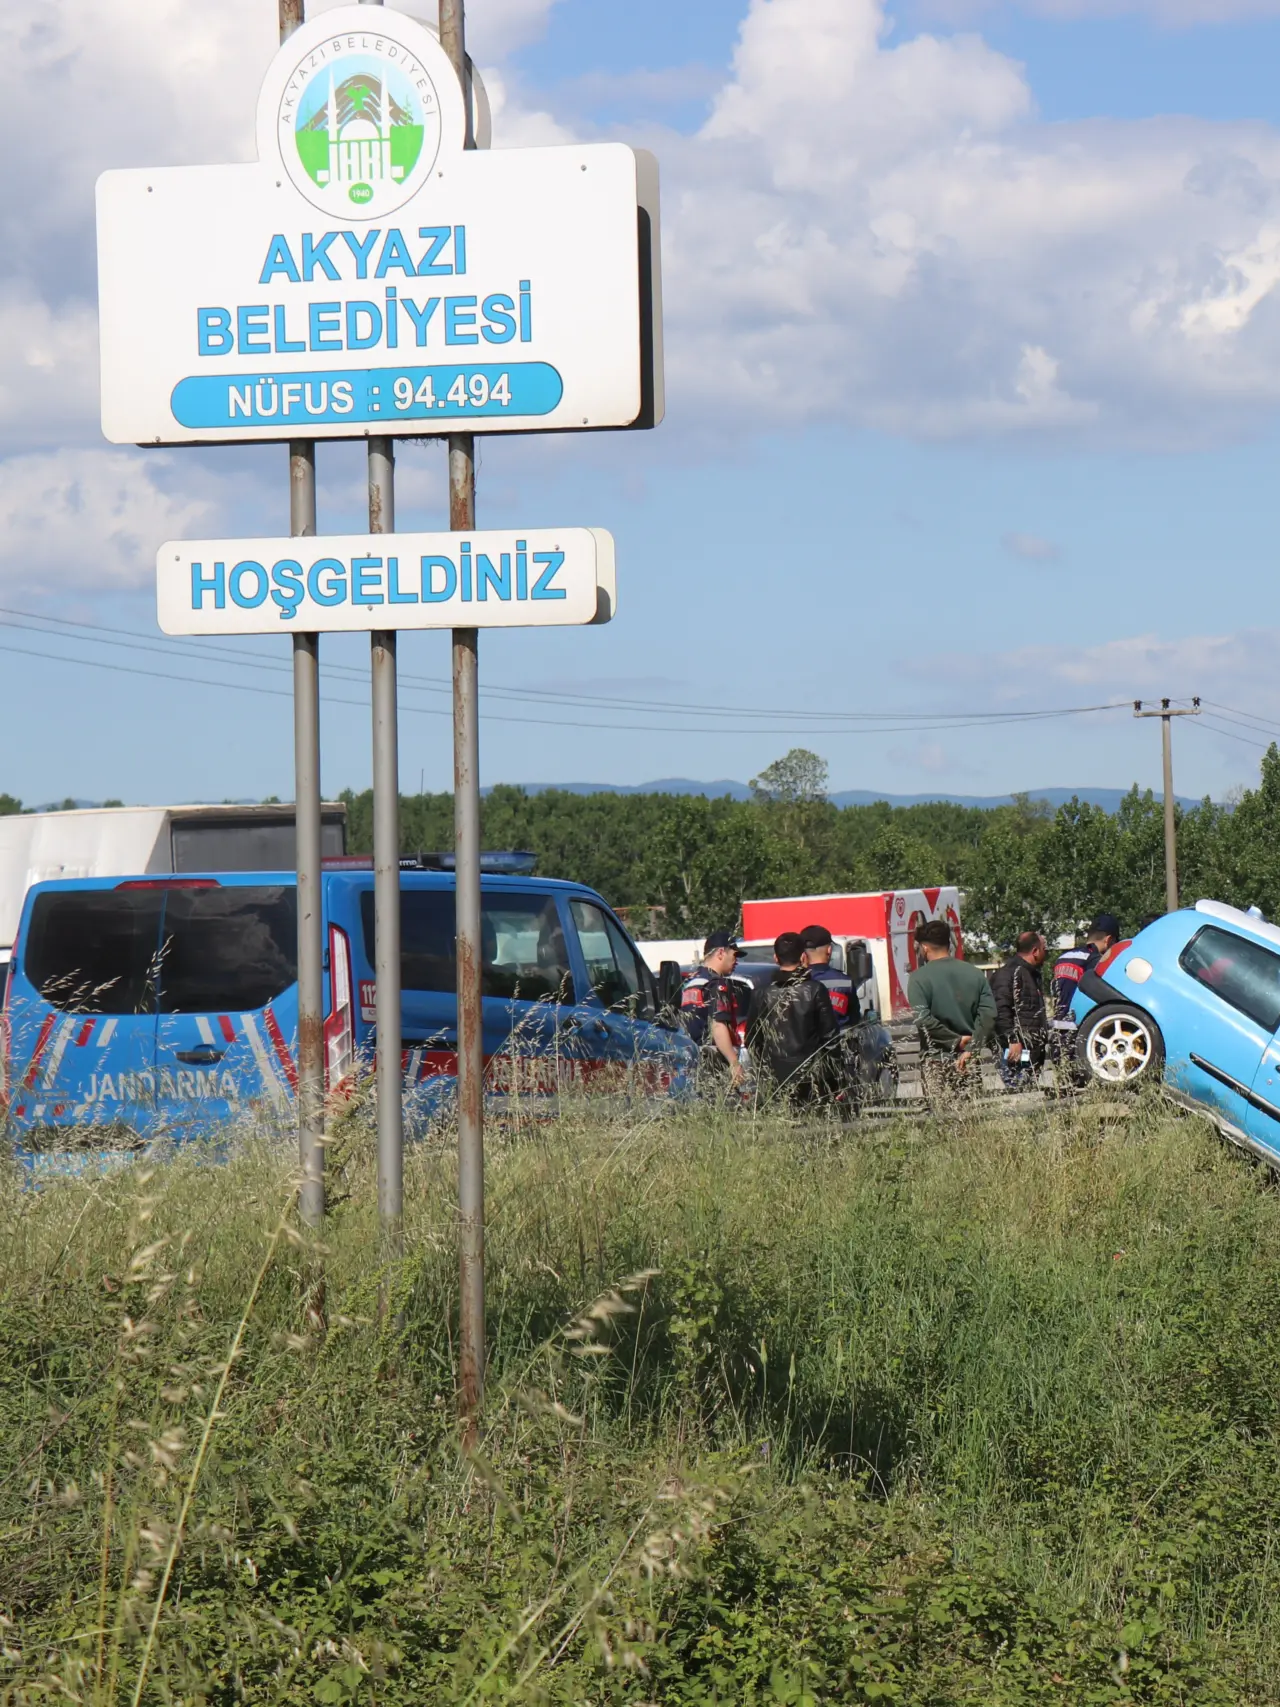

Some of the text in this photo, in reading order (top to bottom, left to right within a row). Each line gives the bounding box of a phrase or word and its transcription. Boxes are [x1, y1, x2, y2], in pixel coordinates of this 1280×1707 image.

[282, 37, 436, 124] AKYAZI BELEDİYESİ
[352, 189, 370, 198] 1940
[258, 225, 467, 284] AKYAZI
[197, 280, 532, 356] BELEDİYESİ
[228, 378, 354, 418] NÜFUS
[392, 373, 512, 411] 94.494
[190, 540, 567, 620] HOŞGELDİNİZ
[84, 1069, 238, 1102] JANDARMA
